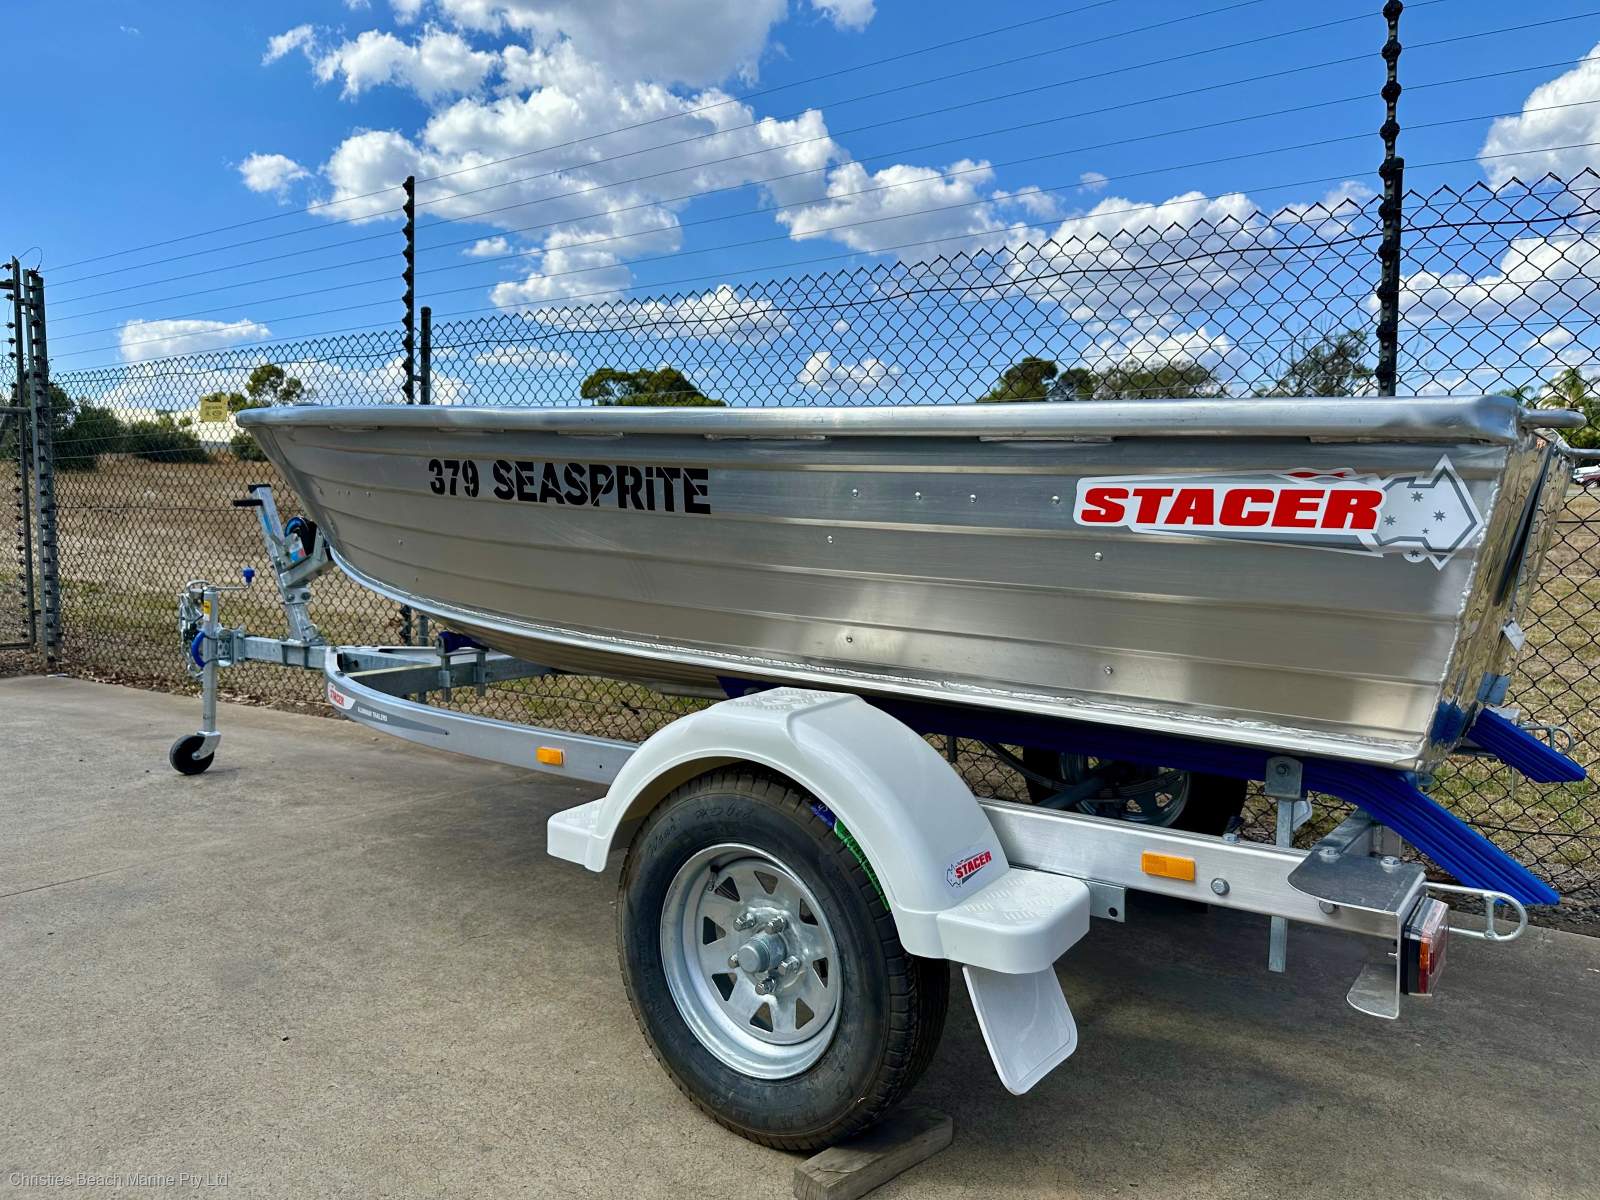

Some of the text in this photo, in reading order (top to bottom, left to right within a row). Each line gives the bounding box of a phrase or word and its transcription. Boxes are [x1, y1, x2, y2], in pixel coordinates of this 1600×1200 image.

[428, 458, 480, 498] 379
[1081, 486, 1384, 530] STACER
[955, 850, 992, 879] STACER
